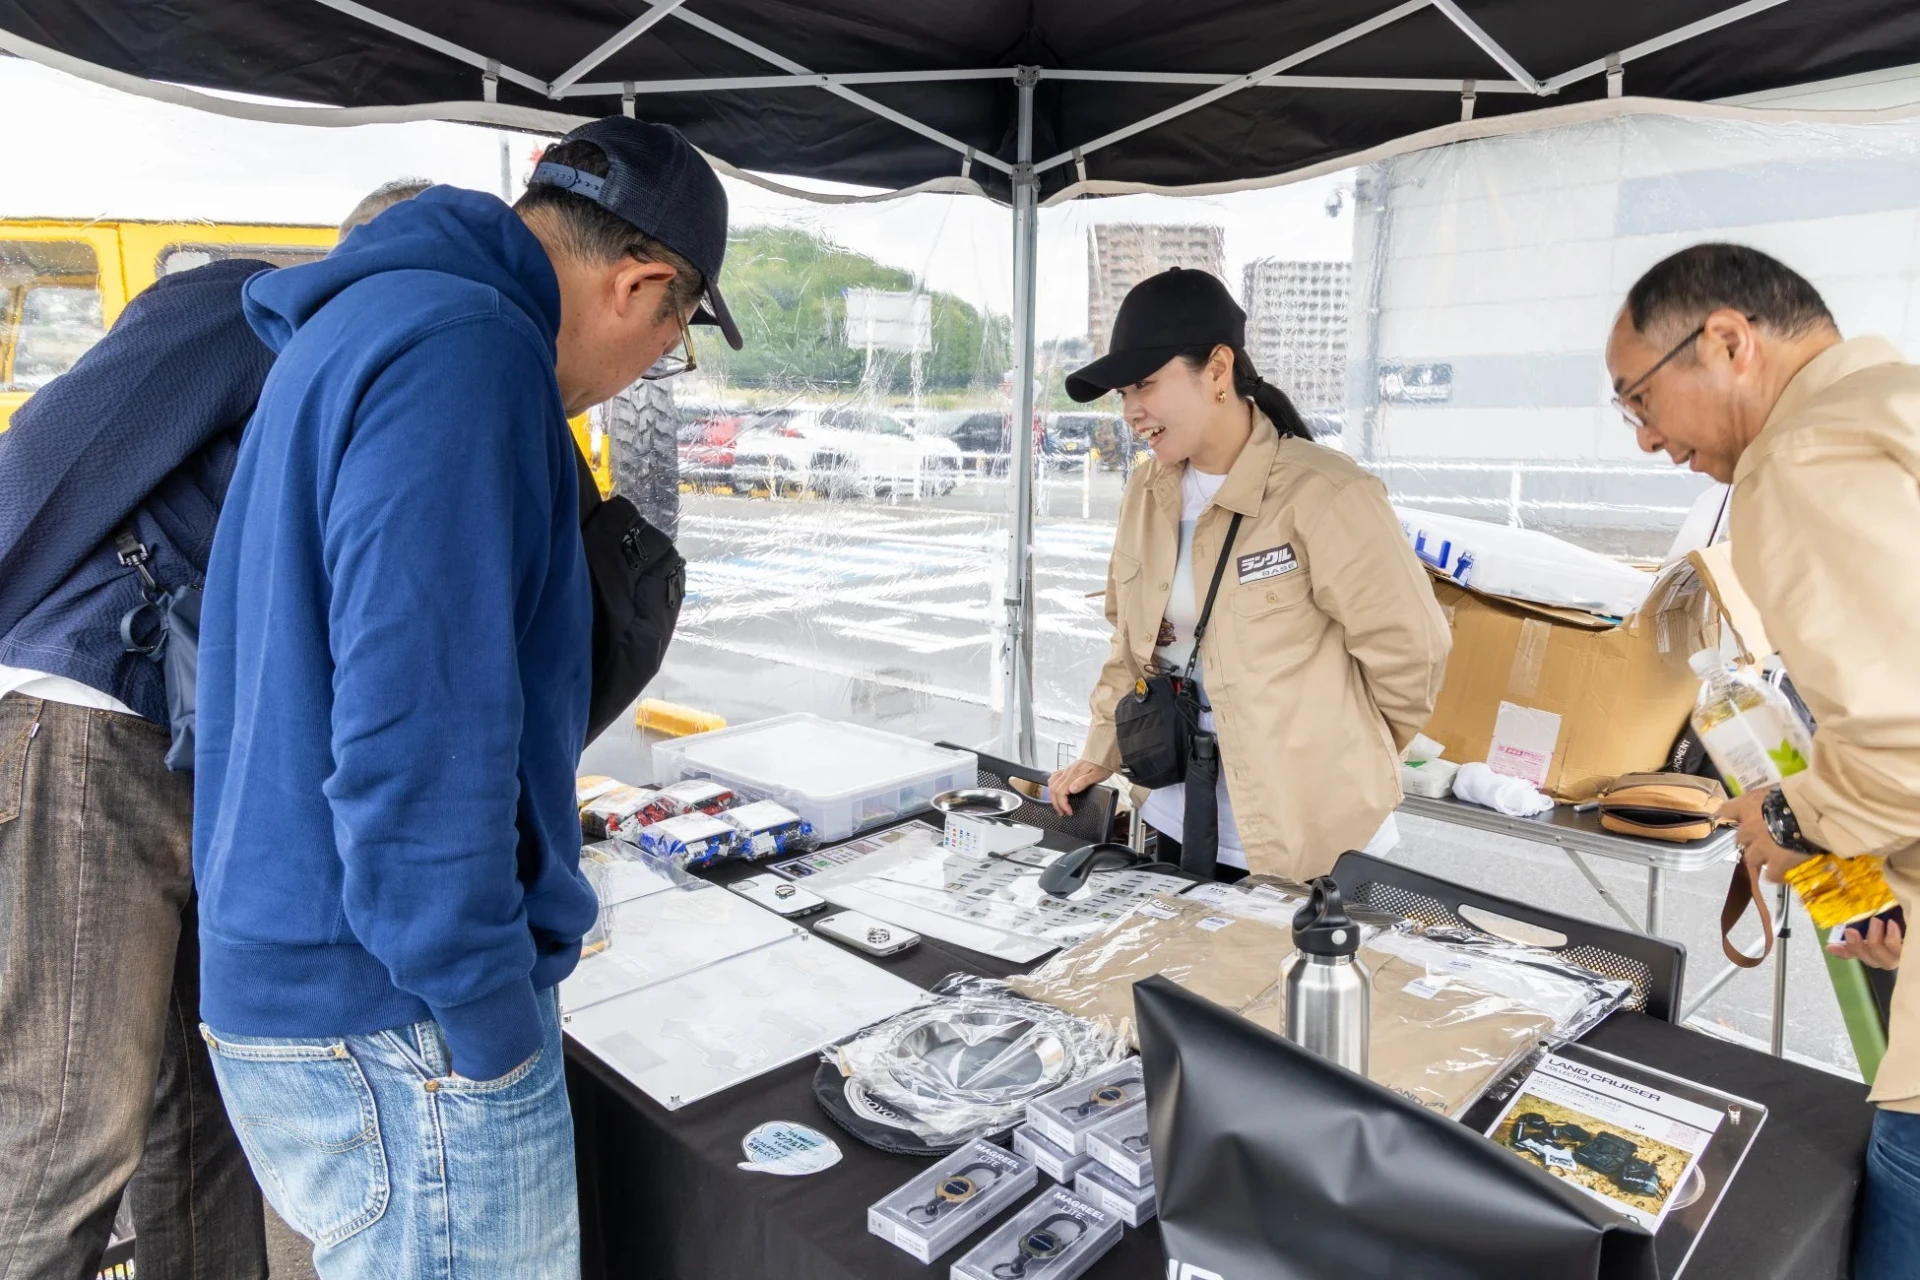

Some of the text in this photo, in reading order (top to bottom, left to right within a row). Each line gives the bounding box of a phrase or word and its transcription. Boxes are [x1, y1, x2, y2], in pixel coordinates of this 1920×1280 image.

[1241, 548, 1292, 572] ランクル
[1261, 562, 1295, 577] BASE
[1544, 1064, 1591, 1084] COLLECTION
[1548, 1058, 1588, 1077] LAND
[1590, 1073, 1661, 1102] CRUISER
[974, 1143, 1019, 1169] MAGREEL
[978, 1154, 1001, 1168] LITE
[1053, 1191, 1105, 1221] MAGREEL
[1060, 1205, 1085, 1220] LITE
